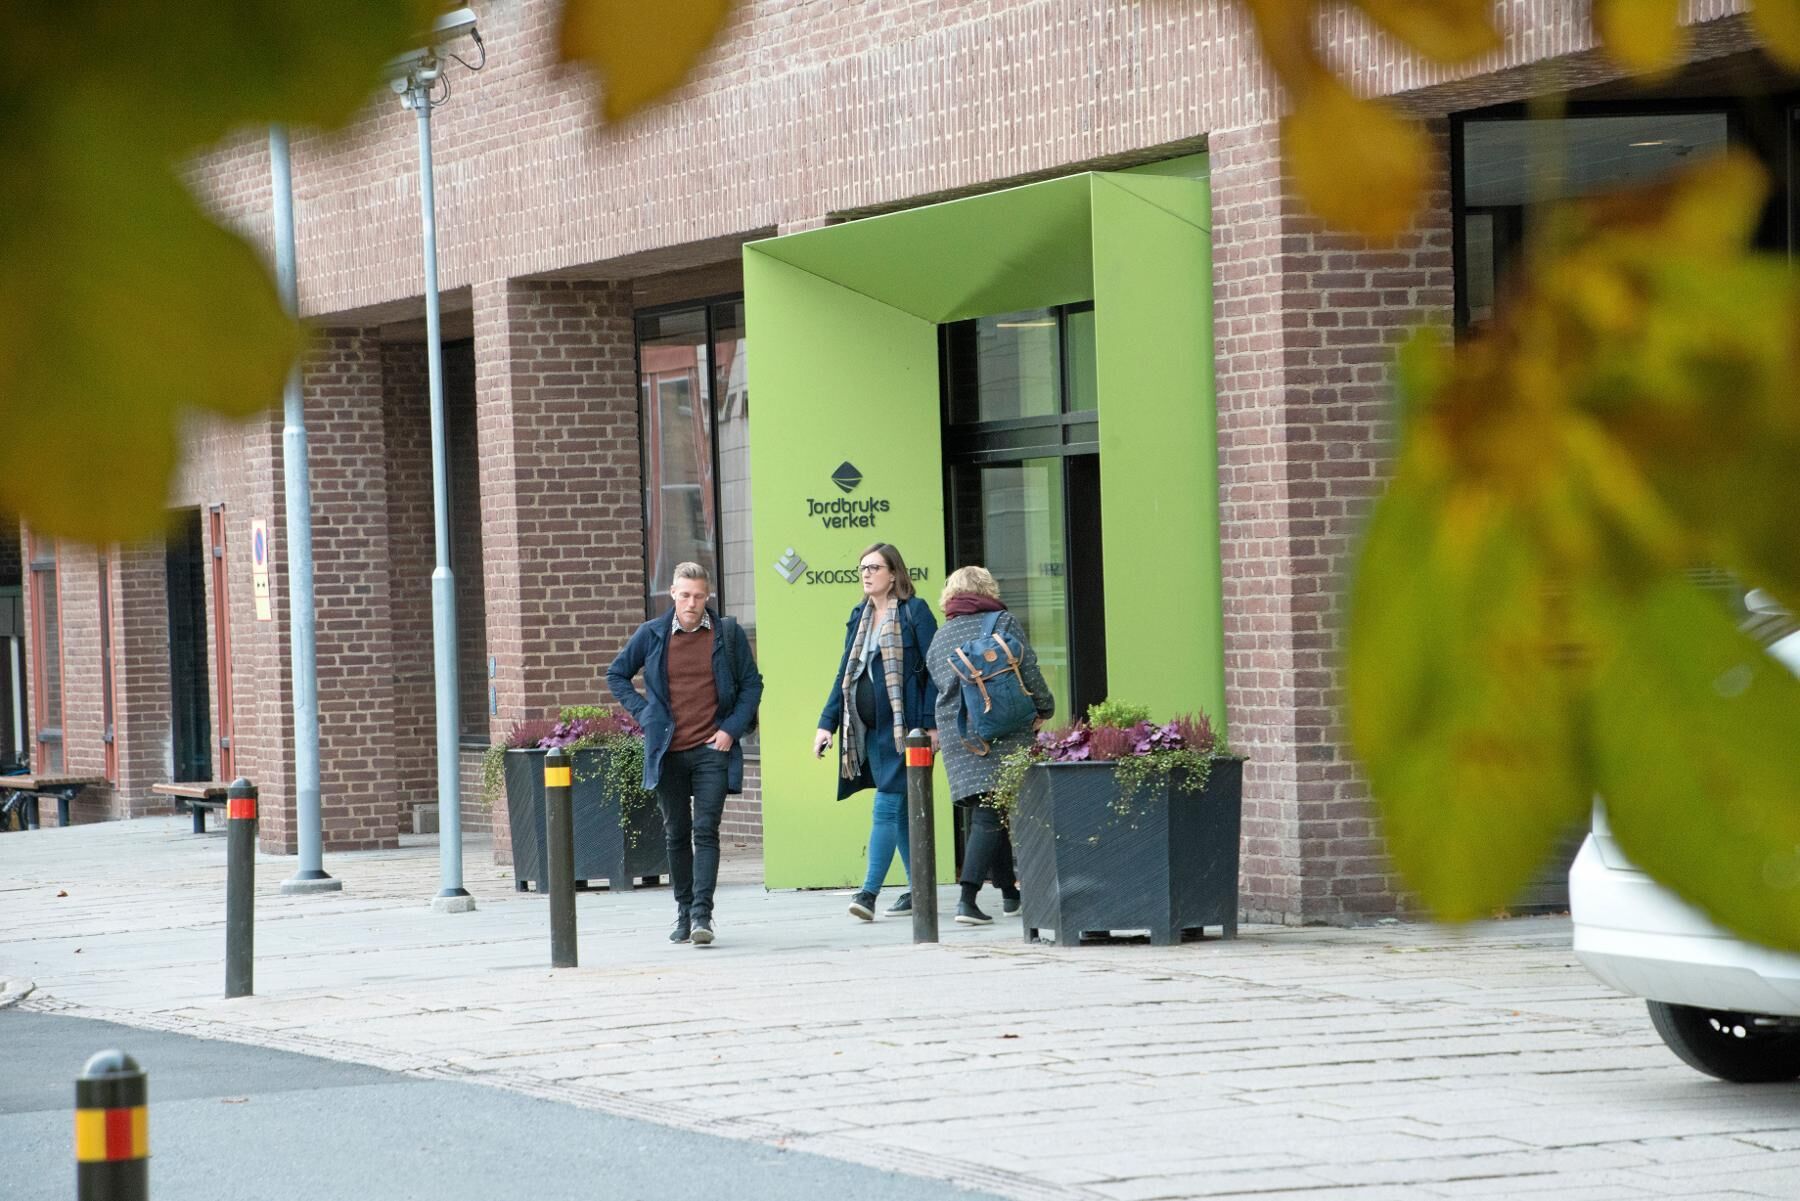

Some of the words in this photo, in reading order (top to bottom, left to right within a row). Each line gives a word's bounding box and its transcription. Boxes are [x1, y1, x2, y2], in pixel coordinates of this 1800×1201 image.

[806, 497, 890, 516] Jordbruks
[822, 513, 876, 528] verket
[806, 566, 928, 584] SKOGSSEN
